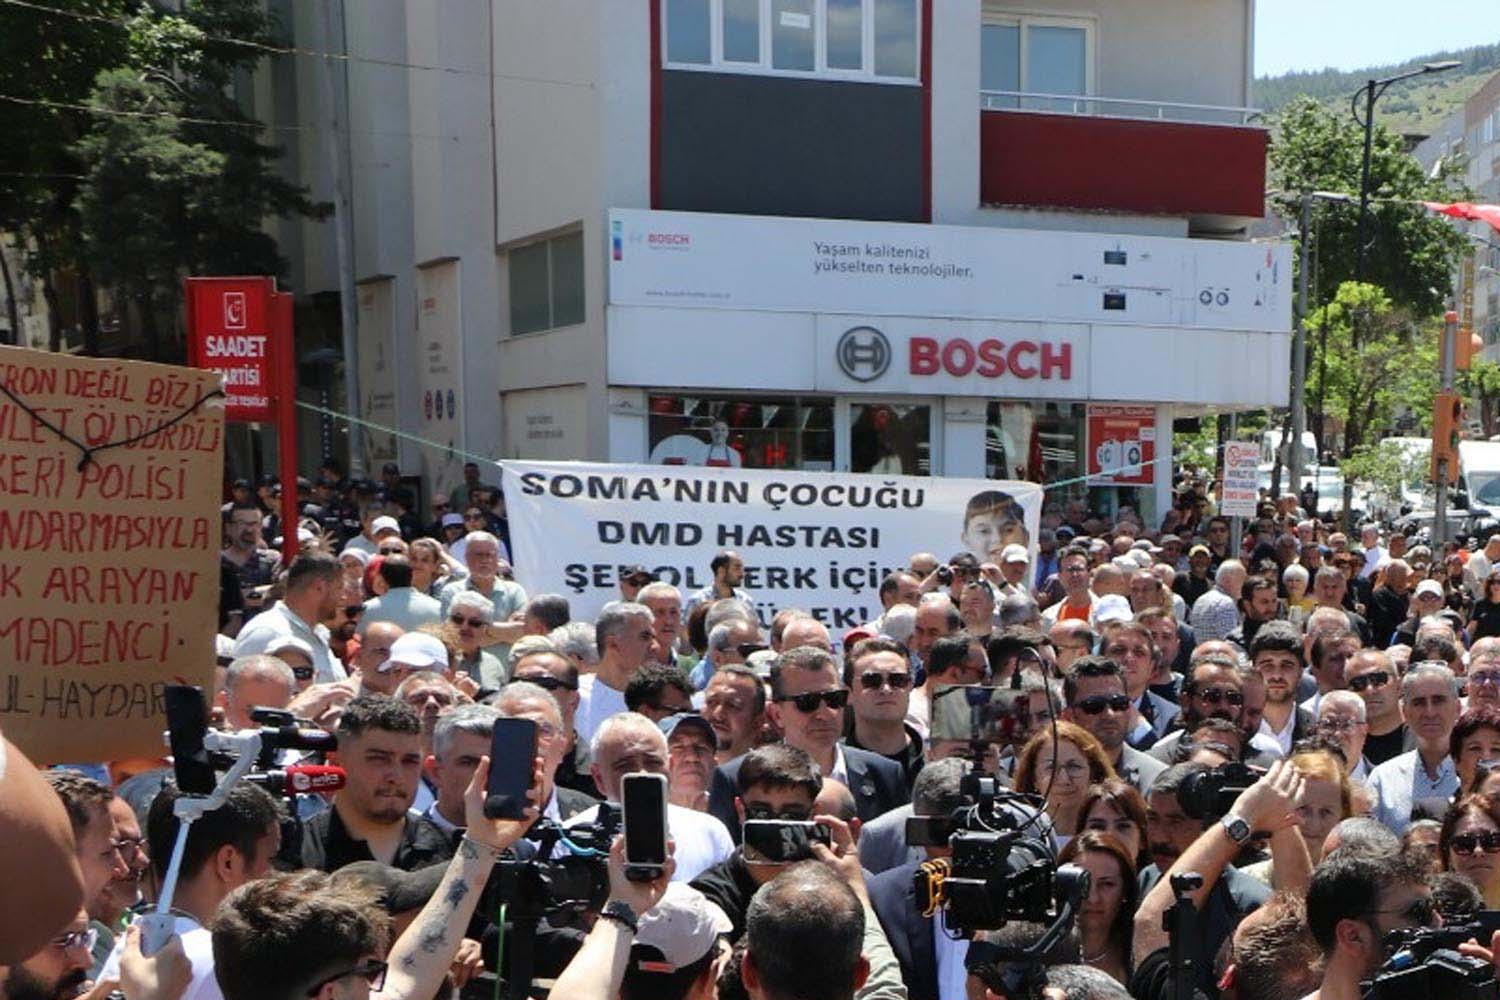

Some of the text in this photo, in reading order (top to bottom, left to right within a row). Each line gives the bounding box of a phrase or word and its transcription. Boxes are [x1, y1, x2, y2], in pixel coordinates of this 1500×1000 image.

[648, 233, 690, 245] BOSCH
[814, 241, 931, 259] Yaşam kalitenizi
[814, 260, 975, 280] yükselten teknolojiler.
[206, 335, 268, 357] SAADET
[909, 336, 1073, 381] BOSCH
[0, 363, 57, 395] RON
[146, 373, 208, 417] BİZİ
[76, 456, 189, 501] POLİSİ
[519, 471, 925, 511] SOMA'NIN ÇOCUĞU
[597, 520, 880, 550] DMD HASTASI
[42, 566, 200, 604] ARAYAN
[564, 563, 704, 594] ŞEOL
[743, 566, 818, 590] ERK
